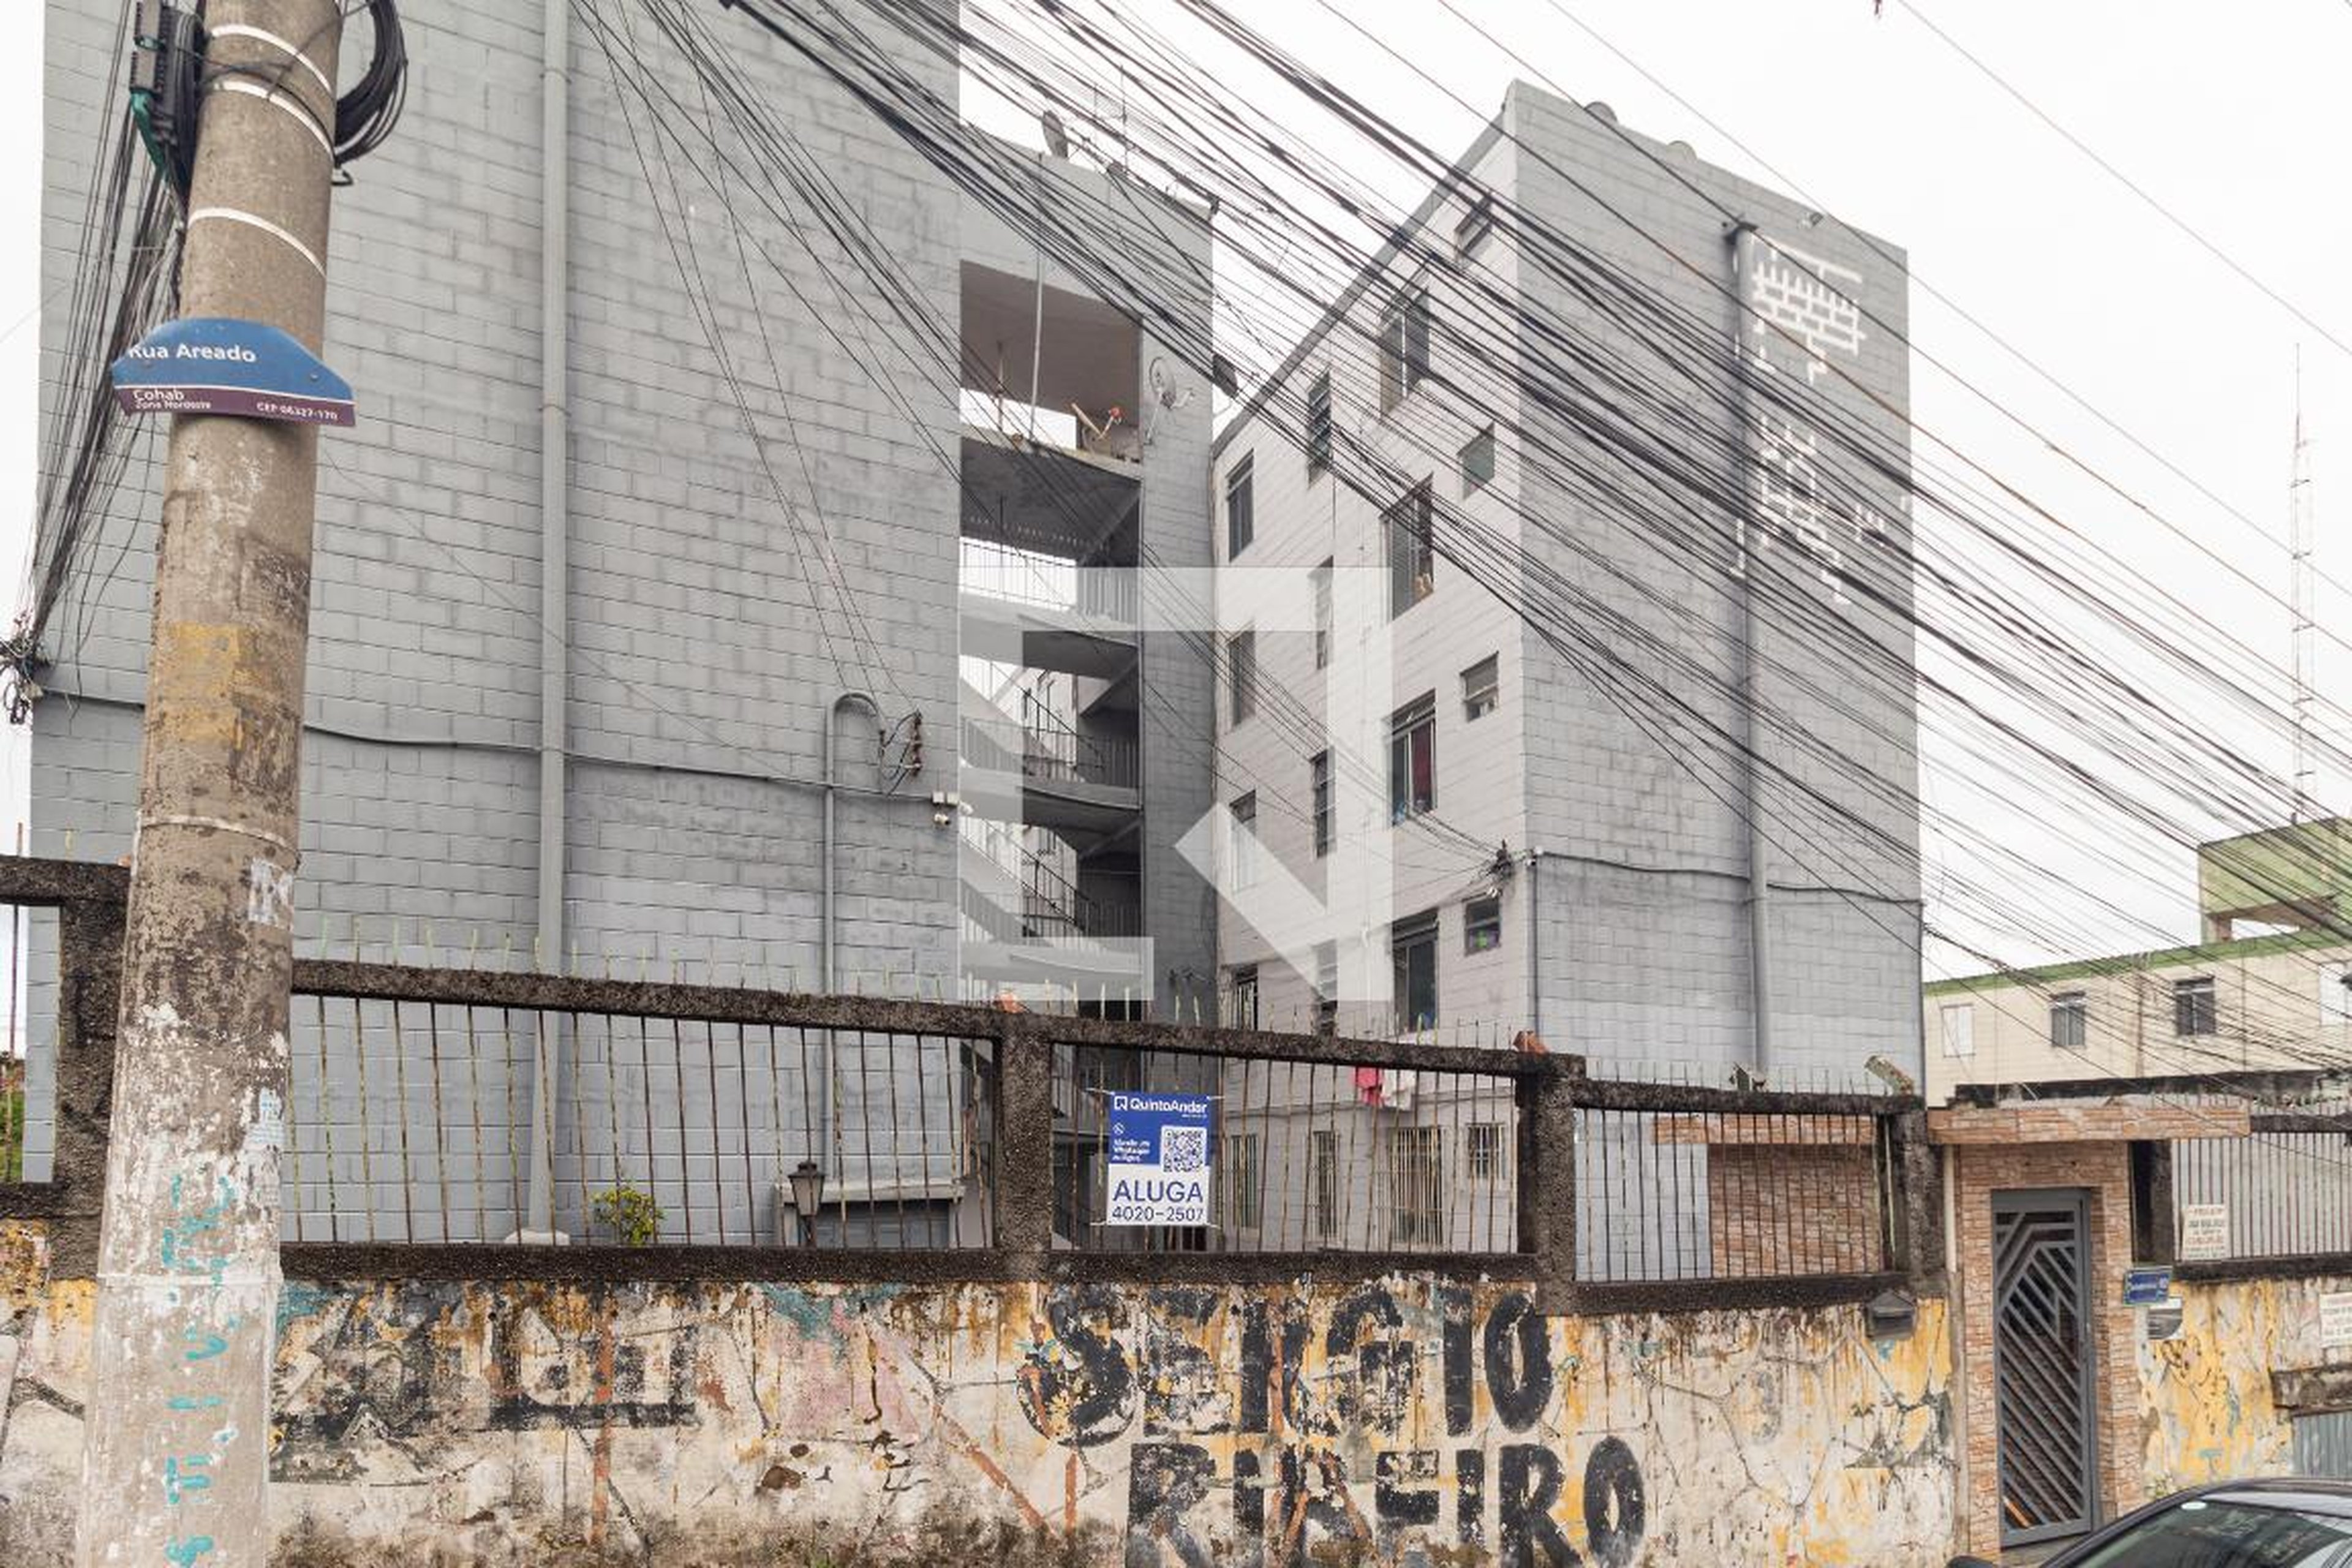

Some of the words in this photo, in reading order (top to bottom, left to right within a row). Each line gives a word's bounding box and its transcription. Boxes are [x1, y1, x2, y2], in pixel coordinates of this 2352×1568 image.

[129, 344, 169, 359] Rua
[176, 342, 257, 363] Areado
[132, 387, 184, 401] Cohab
[256, 401, 277, 412] CEP
[1130, 1098, 1207, 1114] QuintoAndar
[1112, 1179, 1204, 1203] ALUGA
[1112, 1206, 1204, 1222] 4020-2507
